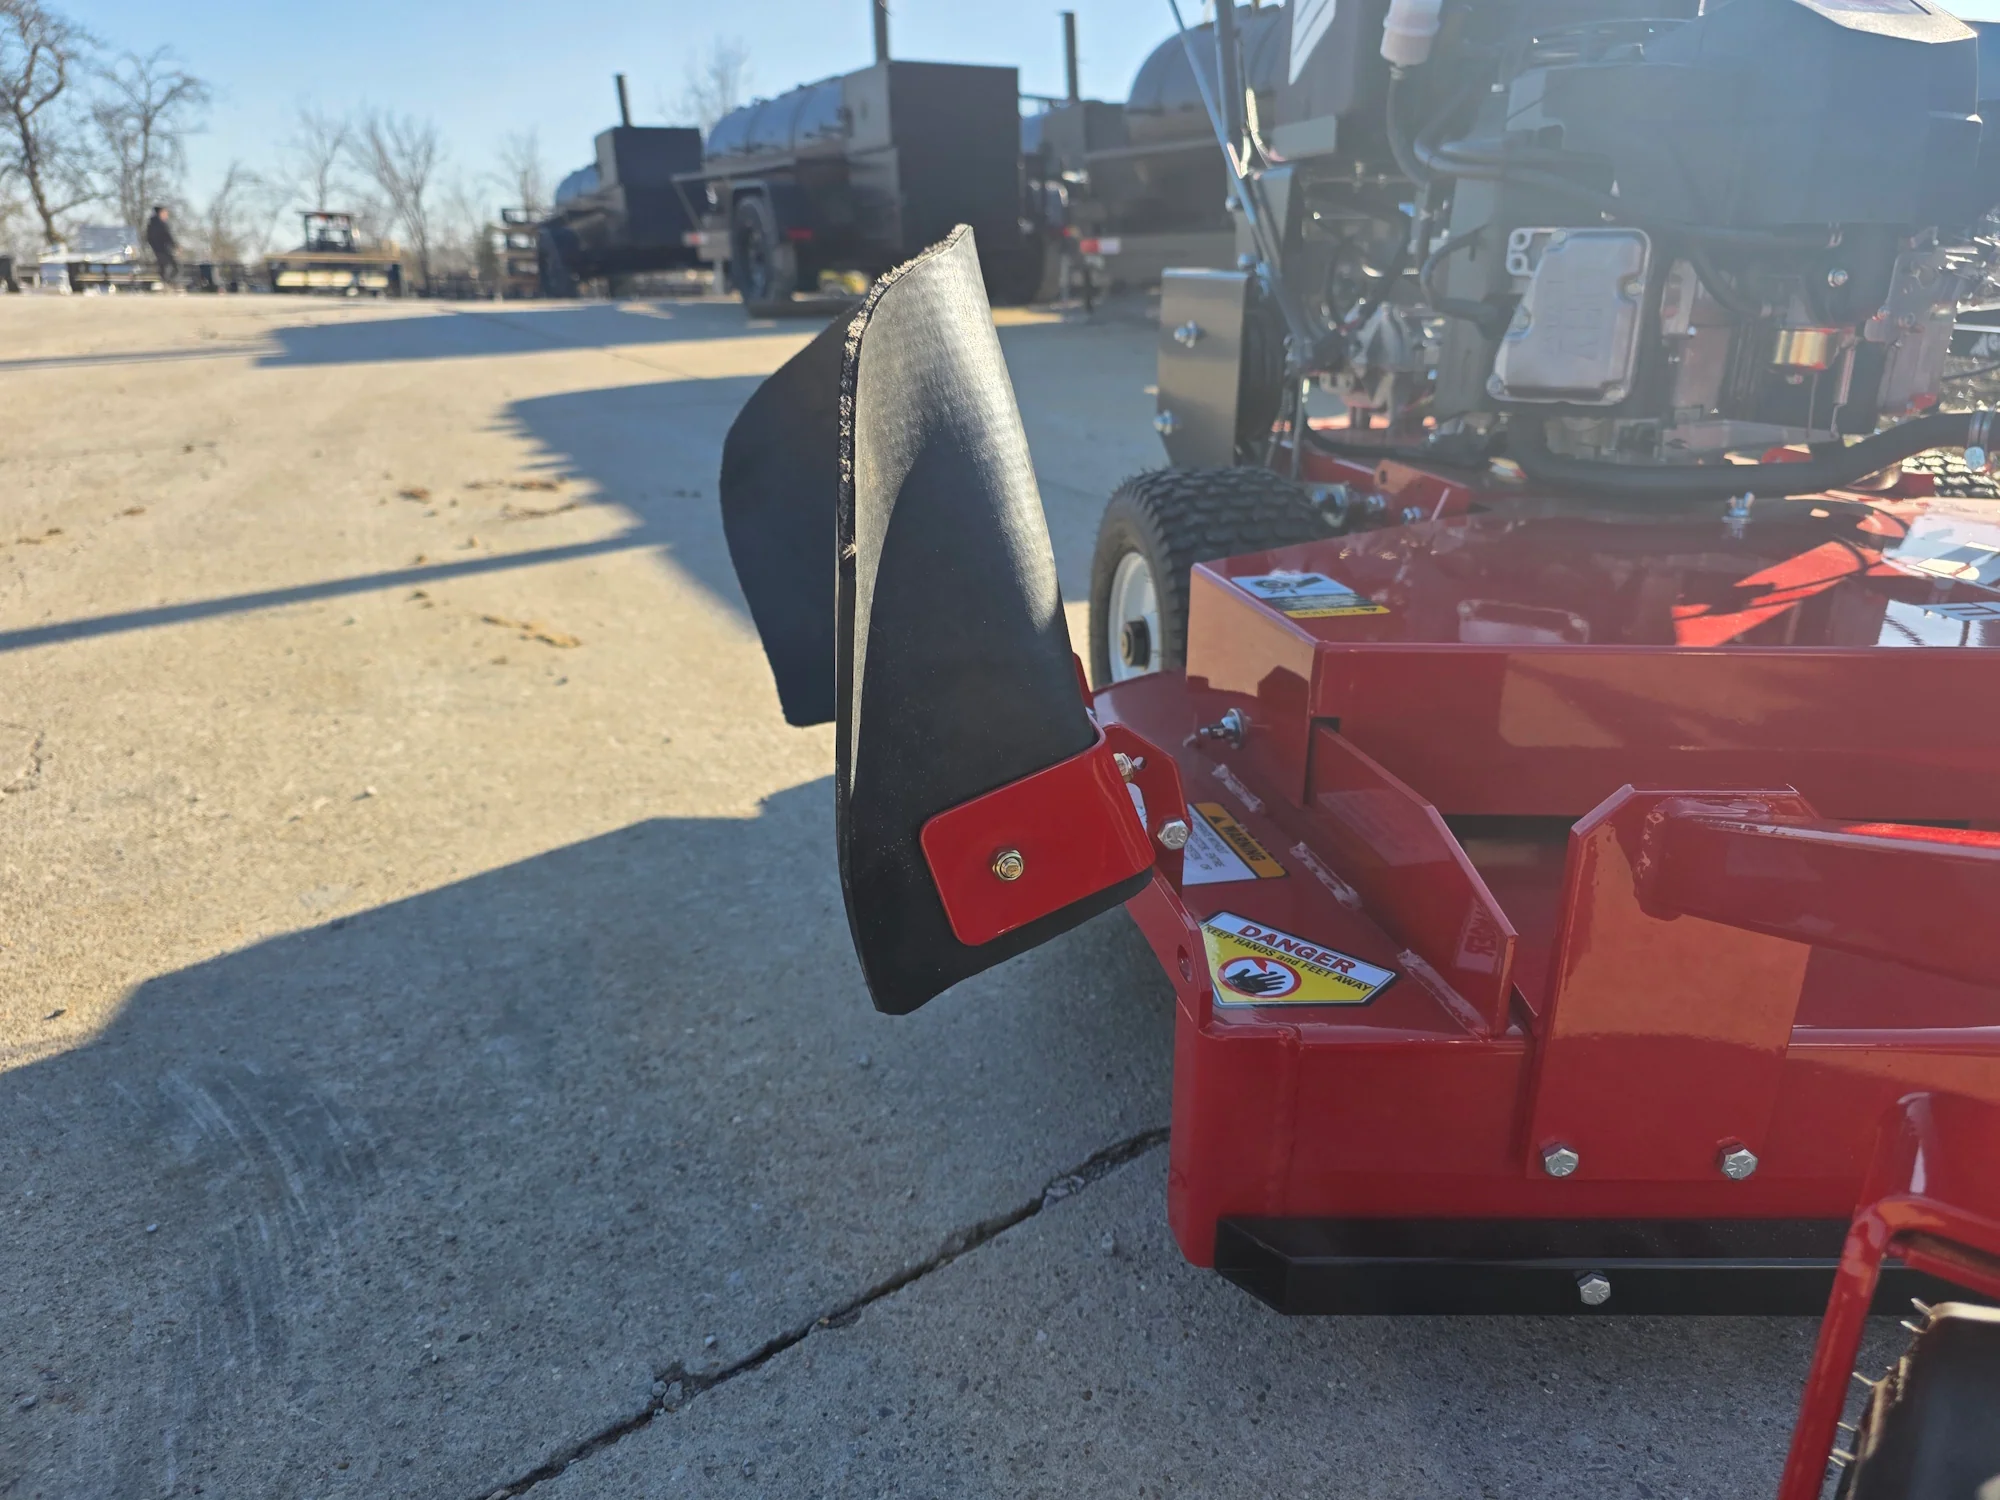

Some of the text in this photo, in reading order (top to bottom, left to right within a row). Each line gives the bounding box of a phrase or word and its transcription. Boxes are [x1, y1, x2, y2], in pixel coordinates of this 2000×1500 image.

[1205, 926, 1373, 992] KEEP HANDS and FEET AWAY
[1237, 925, 1357, 974] DANGER
